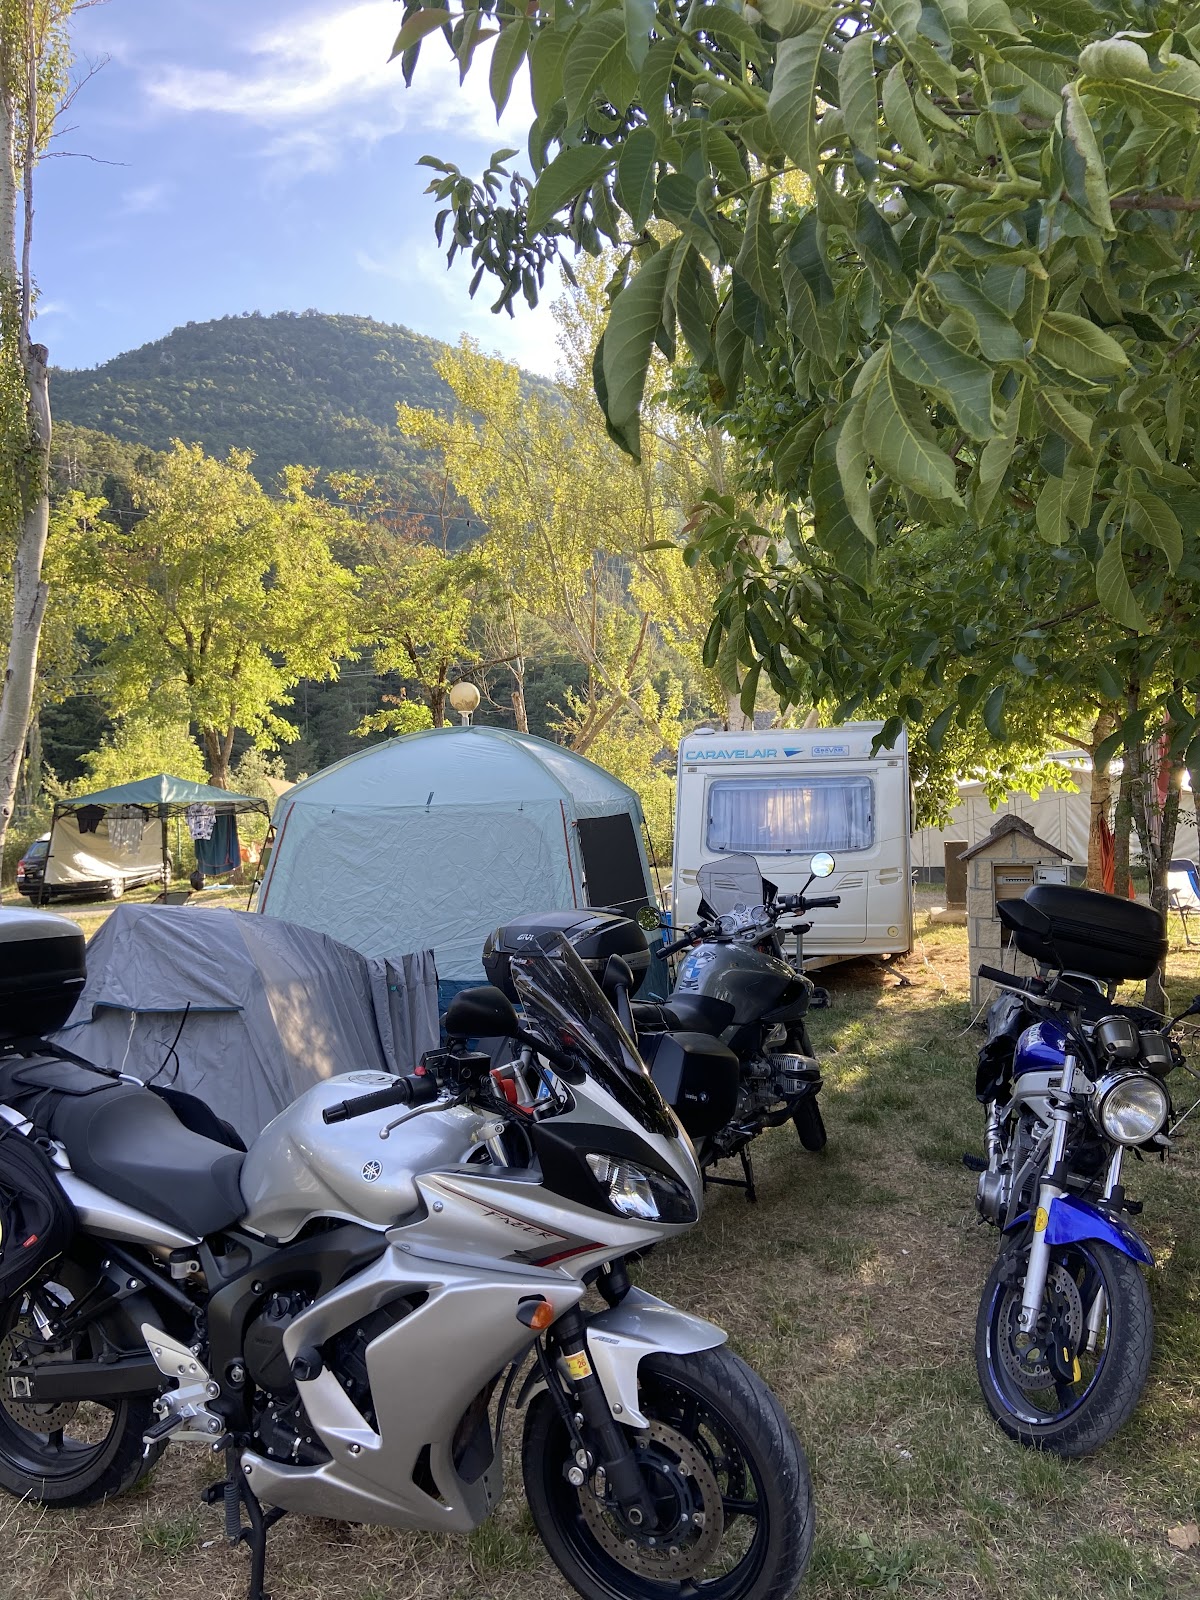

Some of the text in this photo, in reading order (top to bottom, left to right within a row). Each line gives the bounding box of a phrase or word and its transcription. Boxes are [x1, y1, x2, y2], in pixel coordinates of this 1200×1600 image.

[685, 748, 777, 760] CARAVELAIR
[517, 933, 534, 941] GIVI
[481, 1208, 554, 1239] FAZER
